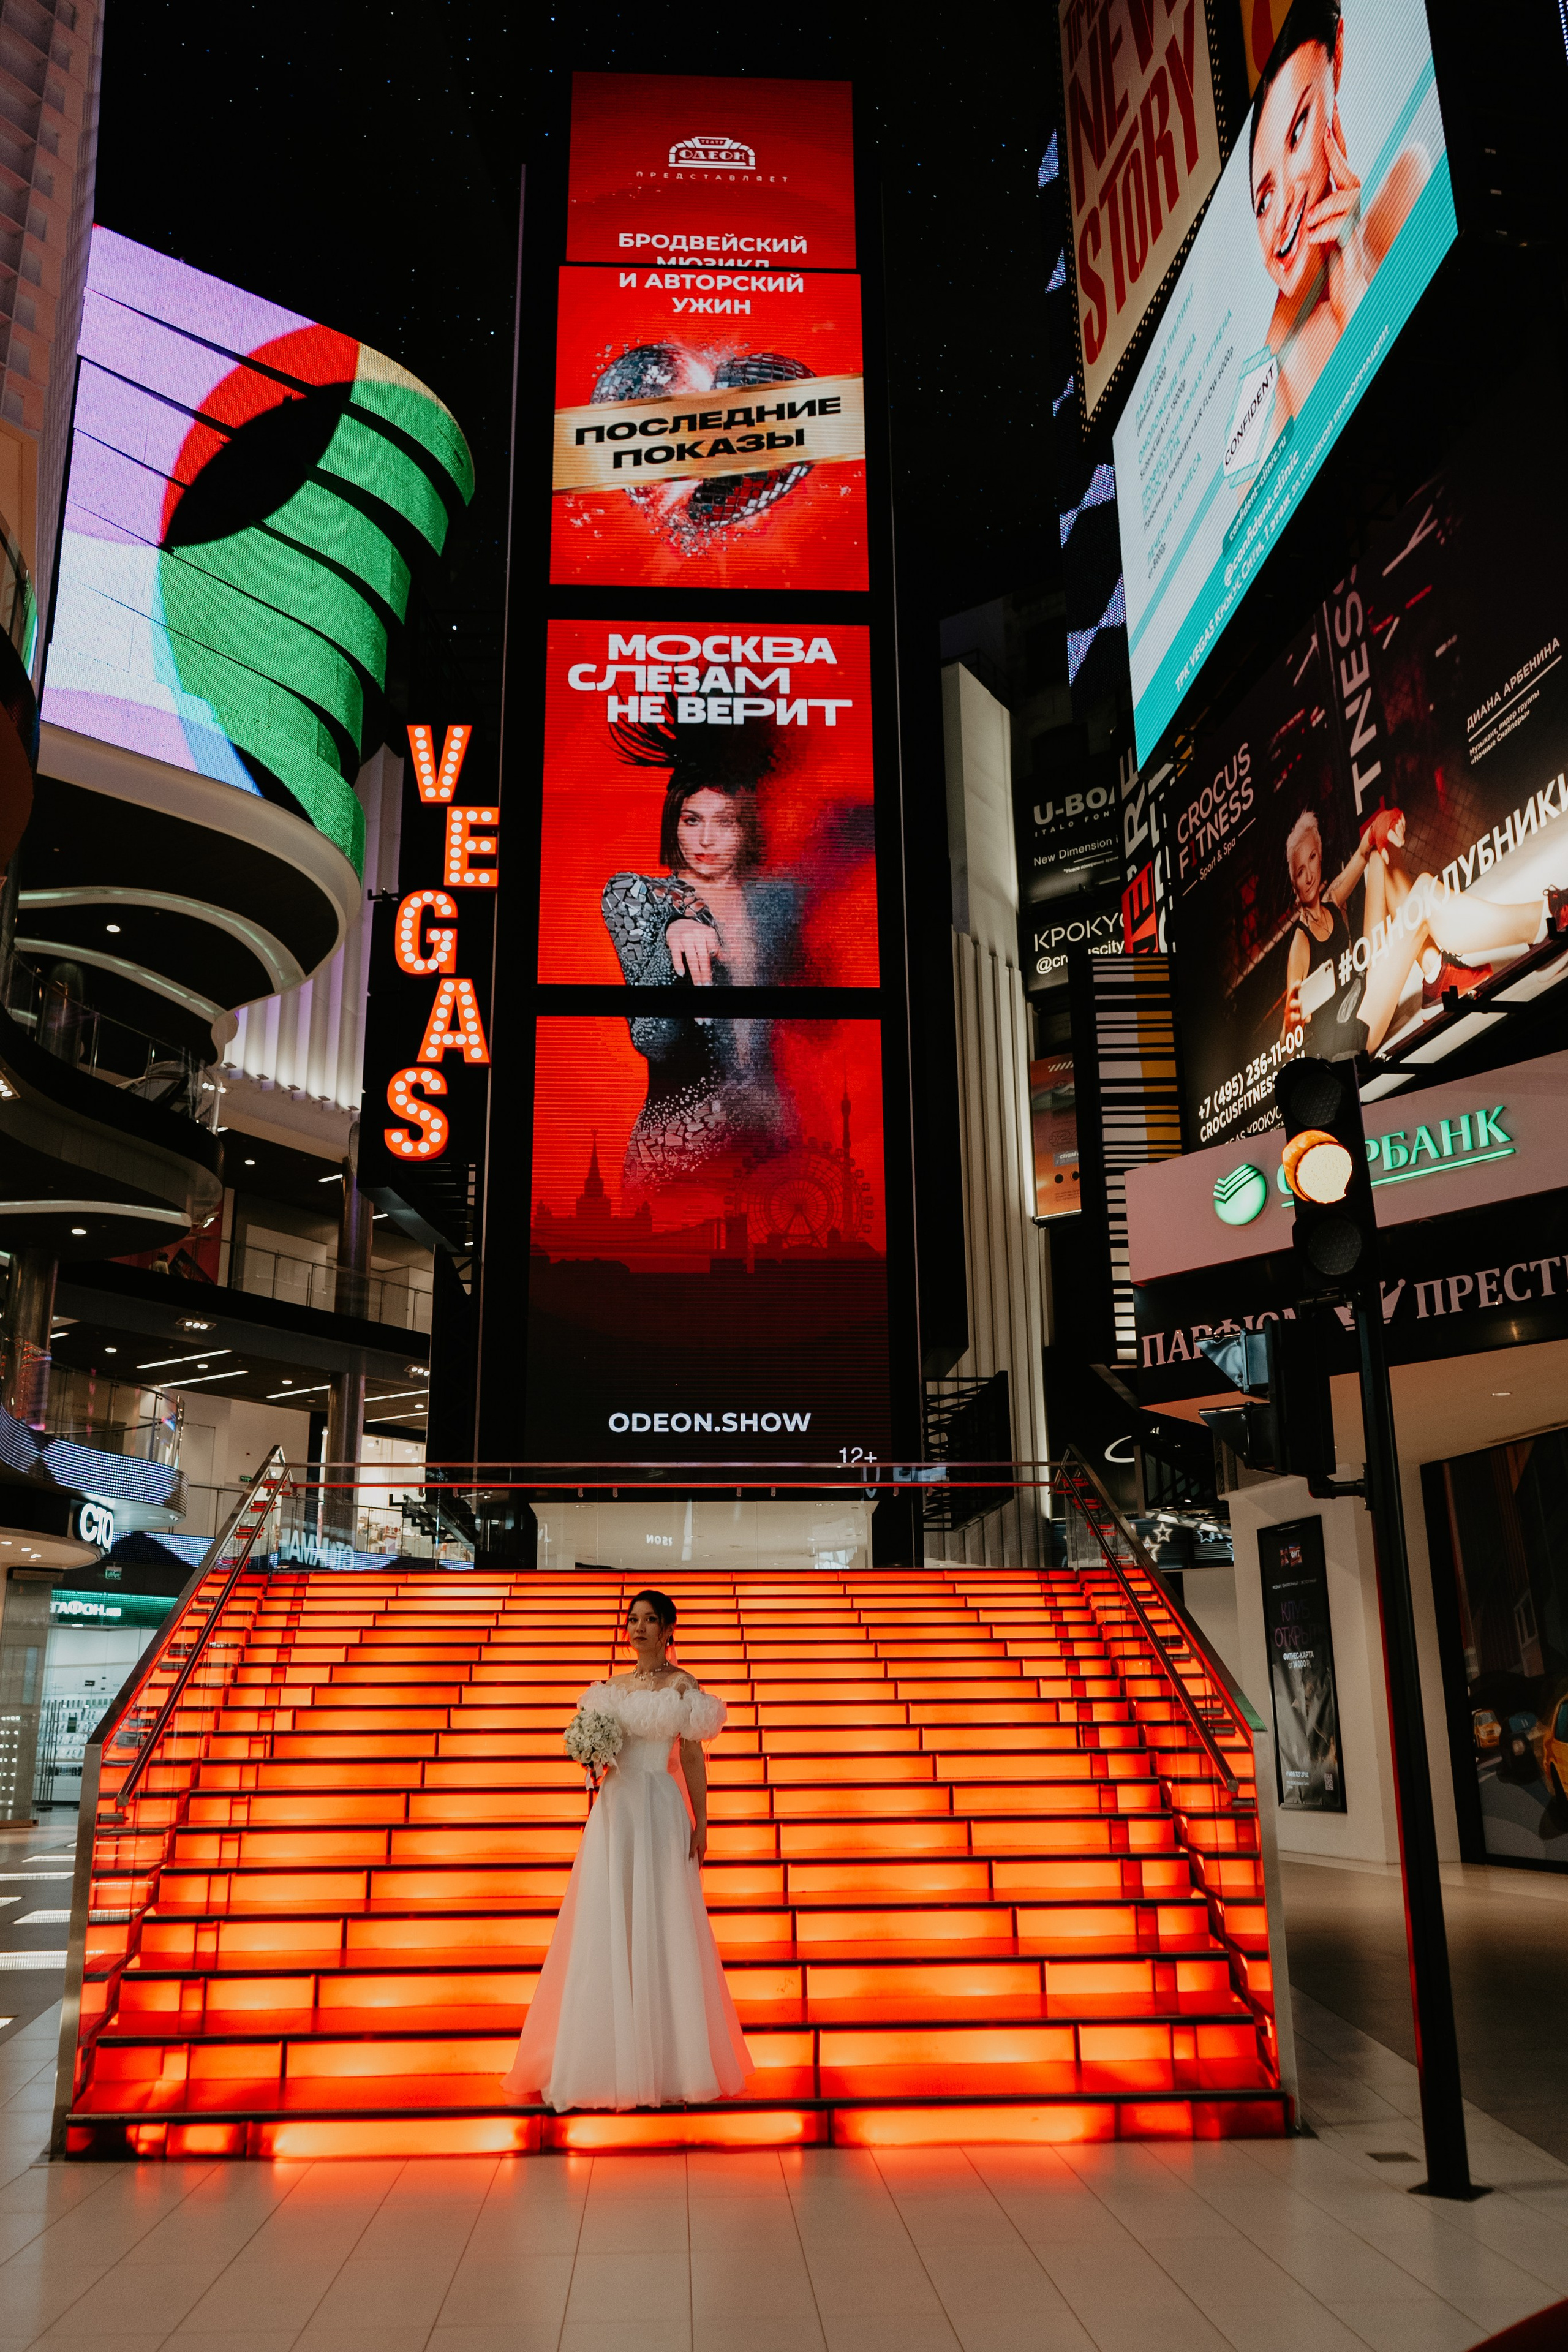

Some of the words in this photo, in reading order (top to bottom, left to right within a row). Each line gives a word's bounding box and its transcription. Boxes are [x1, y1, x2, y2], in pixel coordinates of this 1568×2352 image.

[679, 149, 745, 160] ОДЕОН
[636, 172, 788, 183] ПРЕДСТАВЛЯЕТ
[1078, 0, 1199, 366] STORY
[619, 232, 807, 254] БРОДВЕЙСКИЙ
[619, 273, 637, 288] И
[644, 273, 804, 293] АВТОРСКИЙ
[671, 297, 751, 315] УЖИН
[1137, 369, 1178, 466] ОМОЛОЖЕНИЕ
[1178, 328, 1196, 376] ЛИЦА
[1140, 368, 1202, 506] ПРОФЕССИОНАЛЬНАЯ
[1202, 305, 1232, 376] ГИГИЕНА
[1202, 373, 1218, 413] FLOW
[1224, 361, 1275, 469] CONFIDENT
[575, 396, 841, 446] ПОСЛЕДНИЕ
[612, 429, 805, 469] ПОКАЗЫ
[1147, 506, 1172, 566] ЛЕЧЕНИЕ
[1173, 447, 1201, 515] КАРИЕСА
[1228, 431, 1286, 544] confident-clinic.ru
[1223, 443, 1299, 592] @confident.clinic
[608, 633, 838, 665] МОСКВА
[1189, 616, 1215, 671] VEGAS
[568, 663, 790, 695] СЛЕЗАМ
[1467, 692, 1501, 733] ДИАНА
[1504, 638, 1560, 696] АРБЕНИНА
[607, 695, 666, 723] НЕ
[677, 696, 853, 726] ВЕРИТ
[1469, 727, 1499, 756] Музыкант,
[1499, 710, 1517, 731] лидер
[1517, 690, 1540, 715] группы
[1471, 739, 1496, 765] «Ночные
[1497, 710, 1530, 742] Снайперы»
[1177, 742, 1251, 843] CROCUS
[1035, 821, 1074, 837] ITALO
[1085, 809, 1116, 823] FON
[1034, 854, 1055, 866] New
[1059, 838, 1112, 859] Dimension
[1200, 856, 1216, 880] Sport
[1217, 850, 1222, 862] &
[1223, 837, 1236, 856] Spa
[384, 725, 499, 1161] VEGAS
[1035, 912, 1124, 952] КРОКУ
[1199, 1096, 1211, 1120] +7
[1213, 1072, 1243, 1113] (495)
[1246, 1025, 1303, 1087] 236-11-00
[1414, 1255, 1568, 1318] ПРЕСТ
[609, 1412, 812, 1433] ODEON.SHOW
[839, 1447, 877, 1466] 12+
[80, 1502, 114, 1548] СТО
[1283, 1650, 1314, 1660] ФИТНЕС-КАРТА
